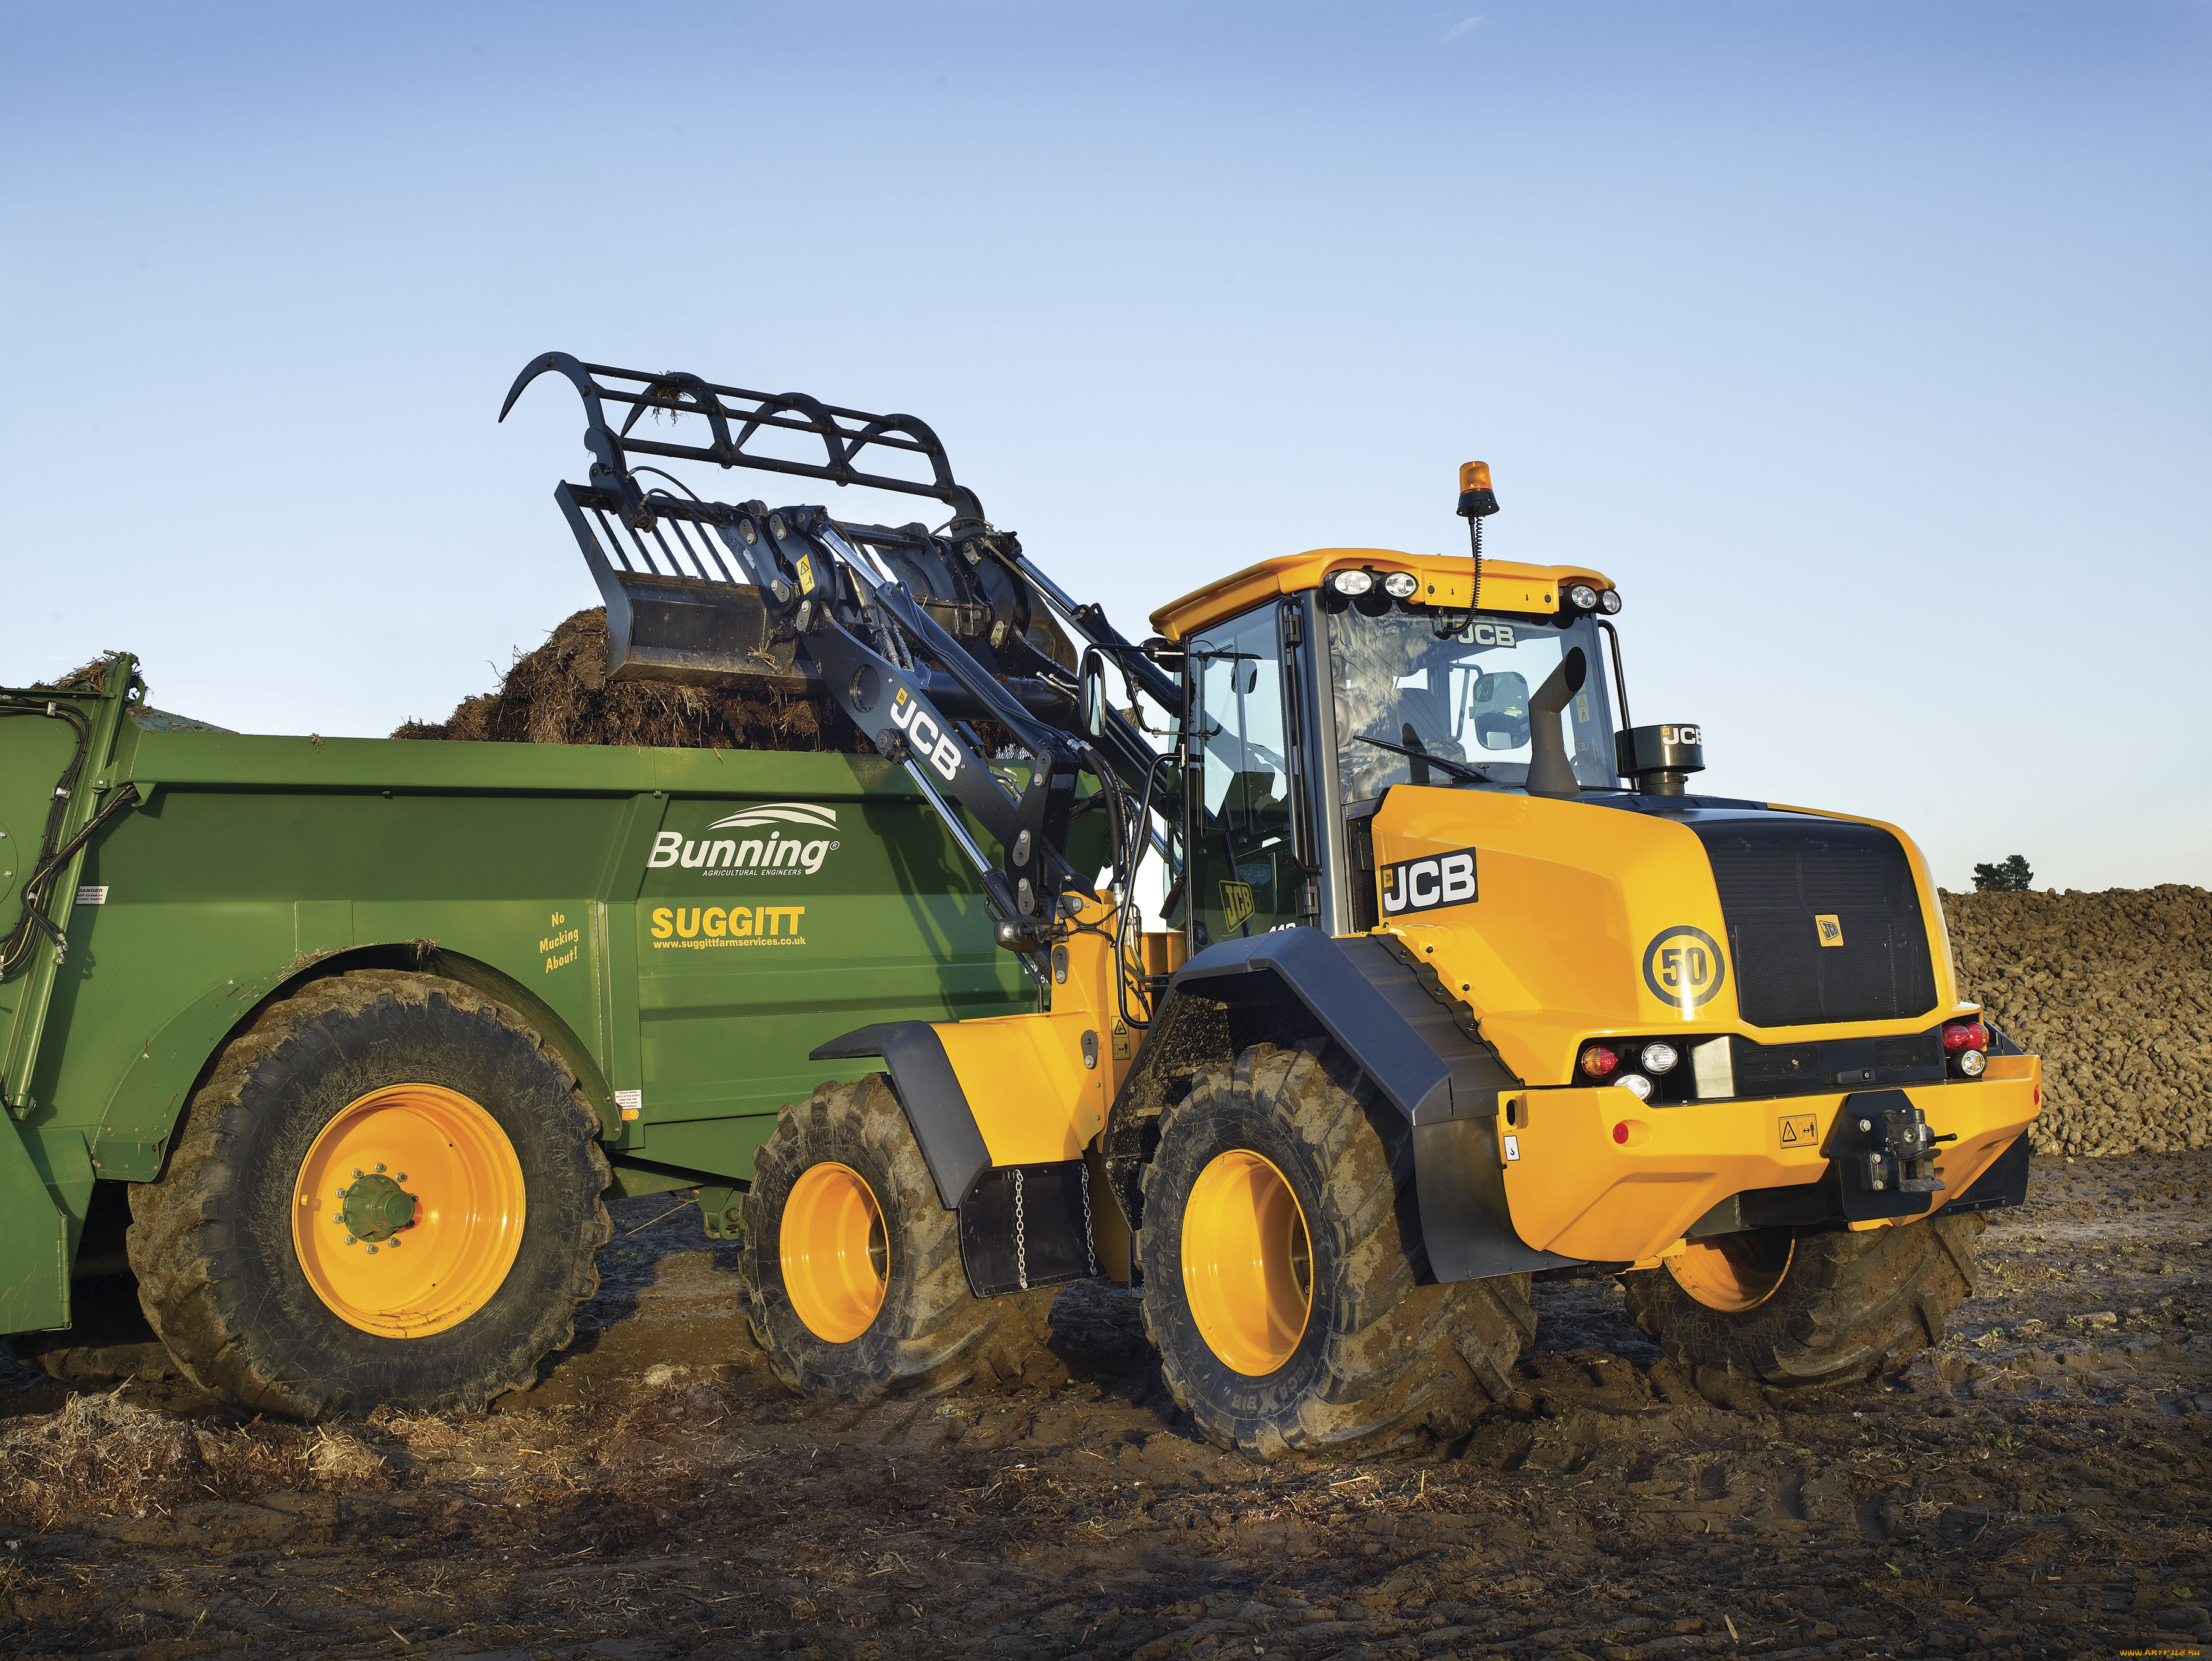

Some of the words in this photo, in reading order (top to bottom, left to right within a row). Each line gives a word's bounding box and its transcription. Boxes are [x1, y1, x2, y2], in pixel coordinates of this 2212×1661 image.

[1457, 624, 1515, 646] JCB
[890, 699, 962, 781] JCB
[1384, 854, 1476, 911] JCB
[551, 911, 565, 927] No
[1225, 885, 1253, 926] JCB
[651, 906, 806, 939] SUGGITT
[1822, 922, 1838, 938] JCB
[539, 929, 579, 954] Mucking
[653, 937, 806, 949] www.suggittfarmservices.co.uk
[546, 945, 578, 973] About!
[1661, 946, 1708, 987] 50
